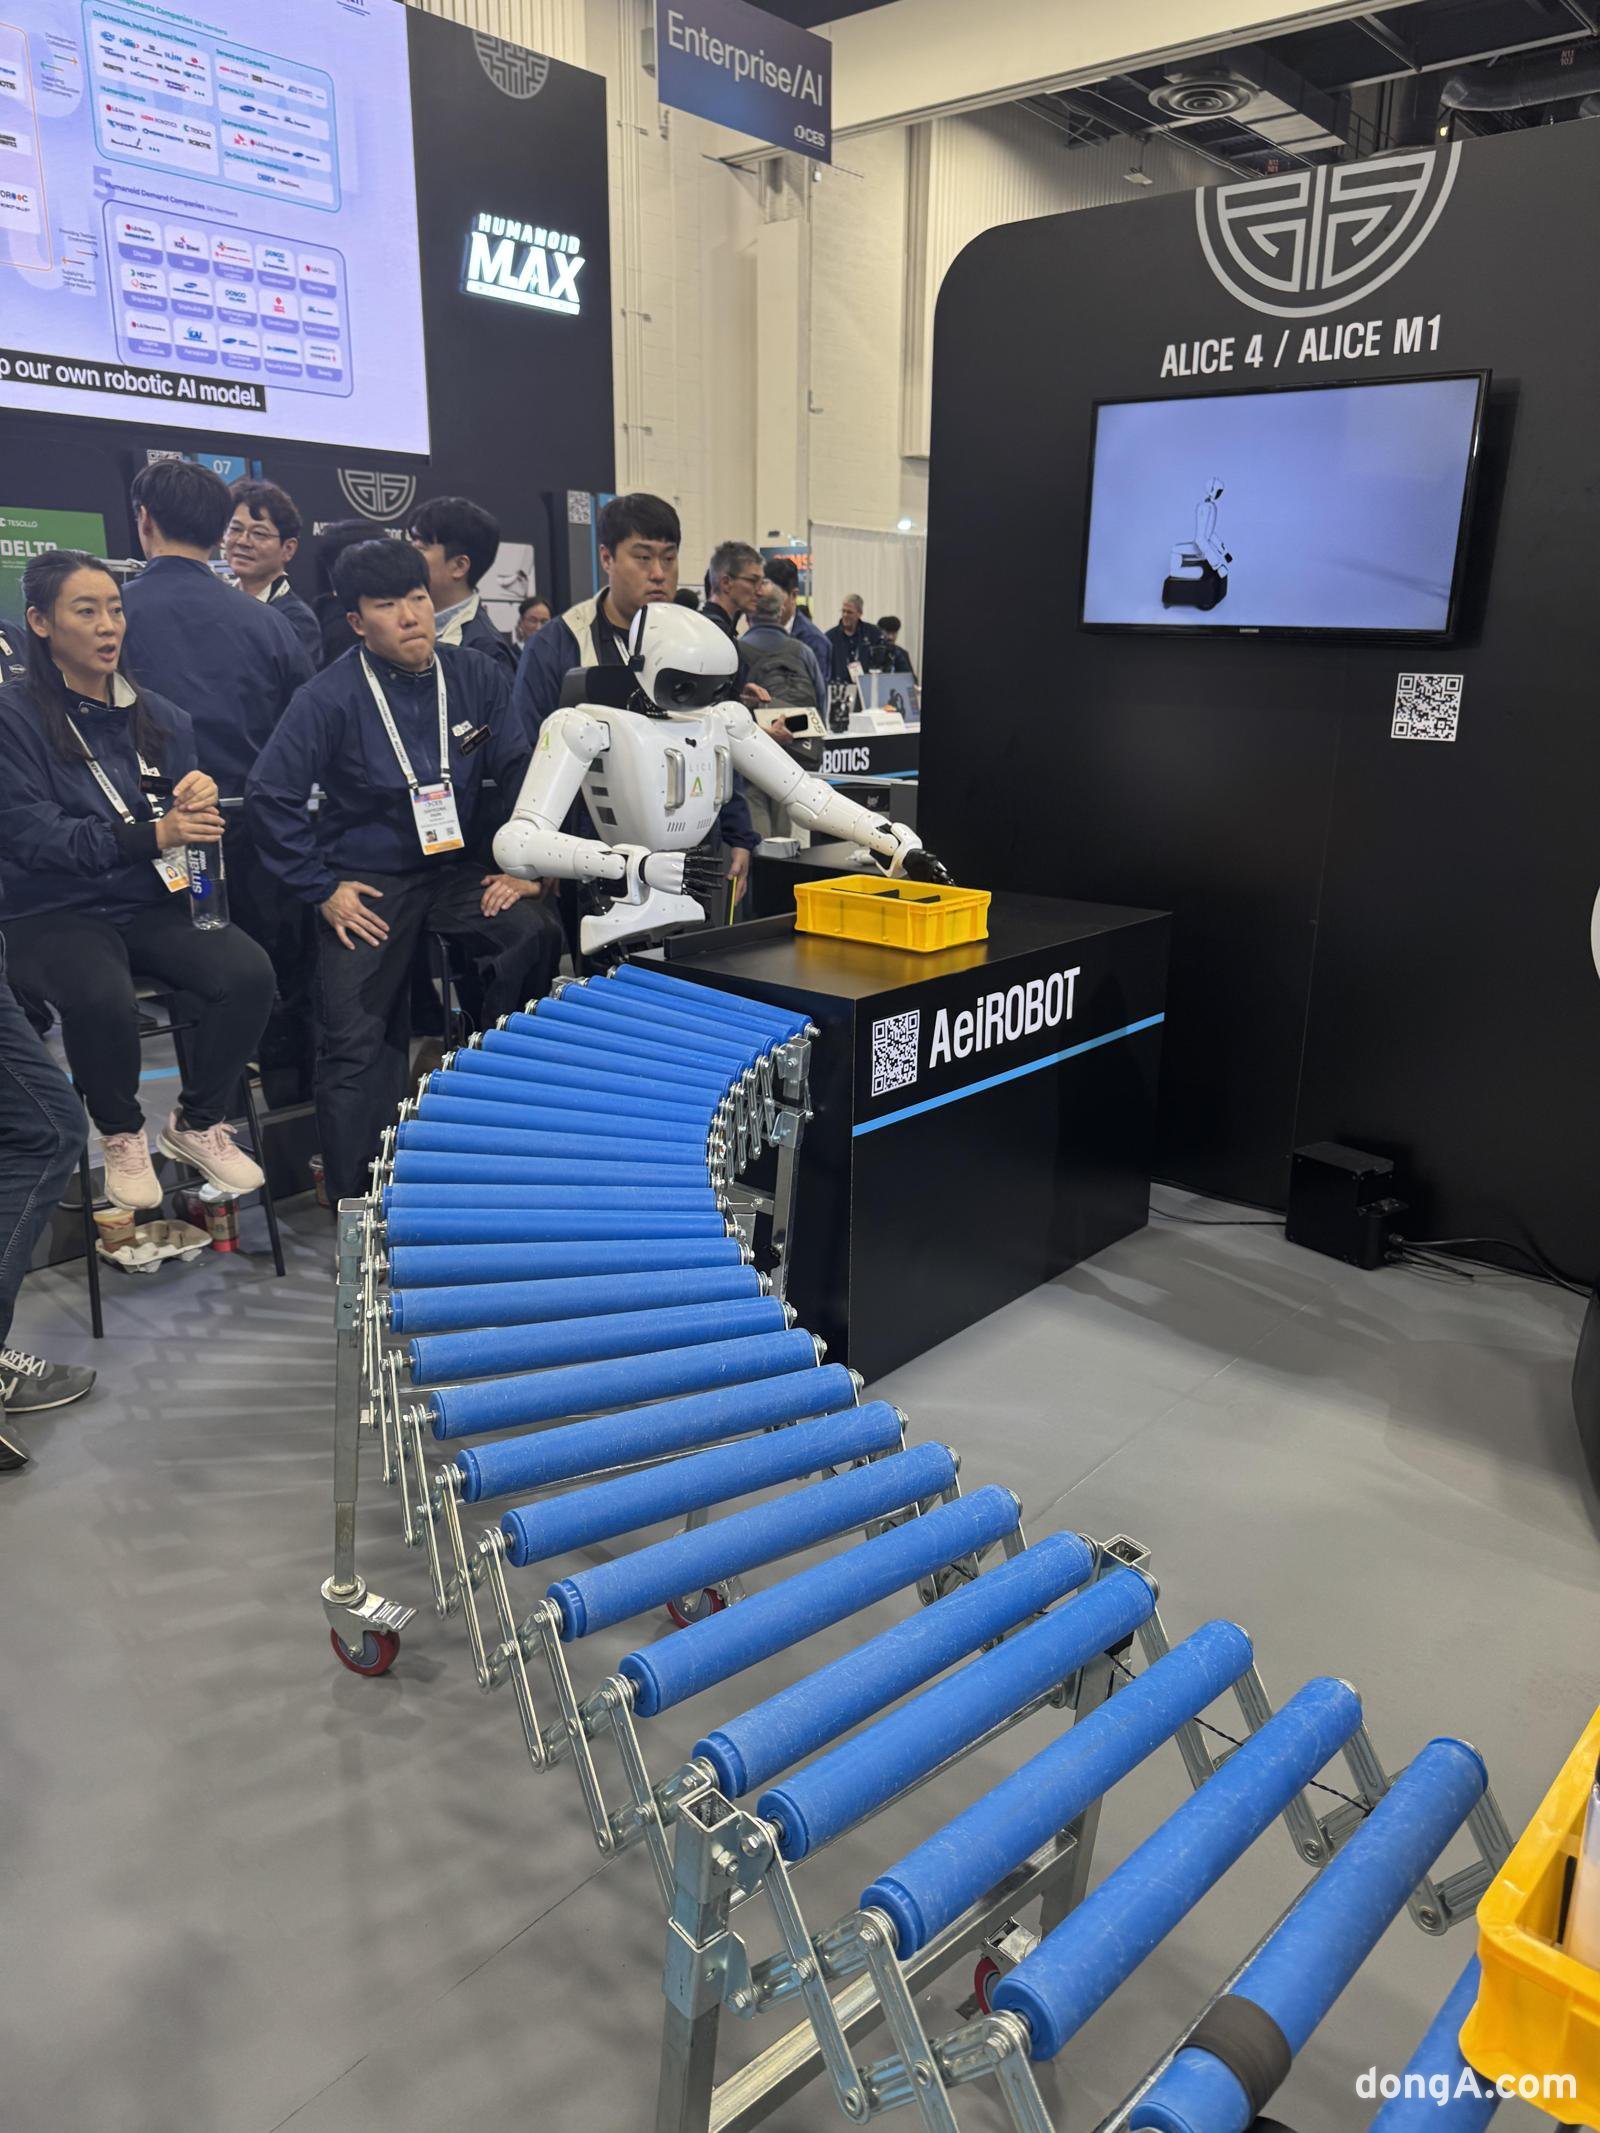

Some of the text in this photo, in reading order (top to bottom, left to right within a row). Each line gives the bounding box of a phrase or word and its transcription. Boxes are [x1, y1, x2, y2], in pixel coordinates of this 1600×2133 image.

[667, 9, 823, 107] Enterprise/AI
[805, 128, 826, 148] CES
[104, 181, 140, 196] Humanoid
[141, 189, 169, 202] Demand
[170, 196, 205, 210] Companies
[478, 212, 581, 255] HUMANOID
[466, 231, 586, 304] MAX
[1160, 314, 1442, 379] ALICE 4 / ALICE M1
[15, 361, 51, 380] our
[55, 366, 101, 387] own
[104, 370, 174, 398] robotic
[178, 378, 197, 399] AI
[200, 385, 261, 408] model.
[213, 460, 232, 475] 07
[8, 519, 38, 528] TESOLLO
[819, 747, 870, 774] BOTICS
[189, 850, 203, 894] smart
[929, 966, 1081, 1068] AeiROBOT
